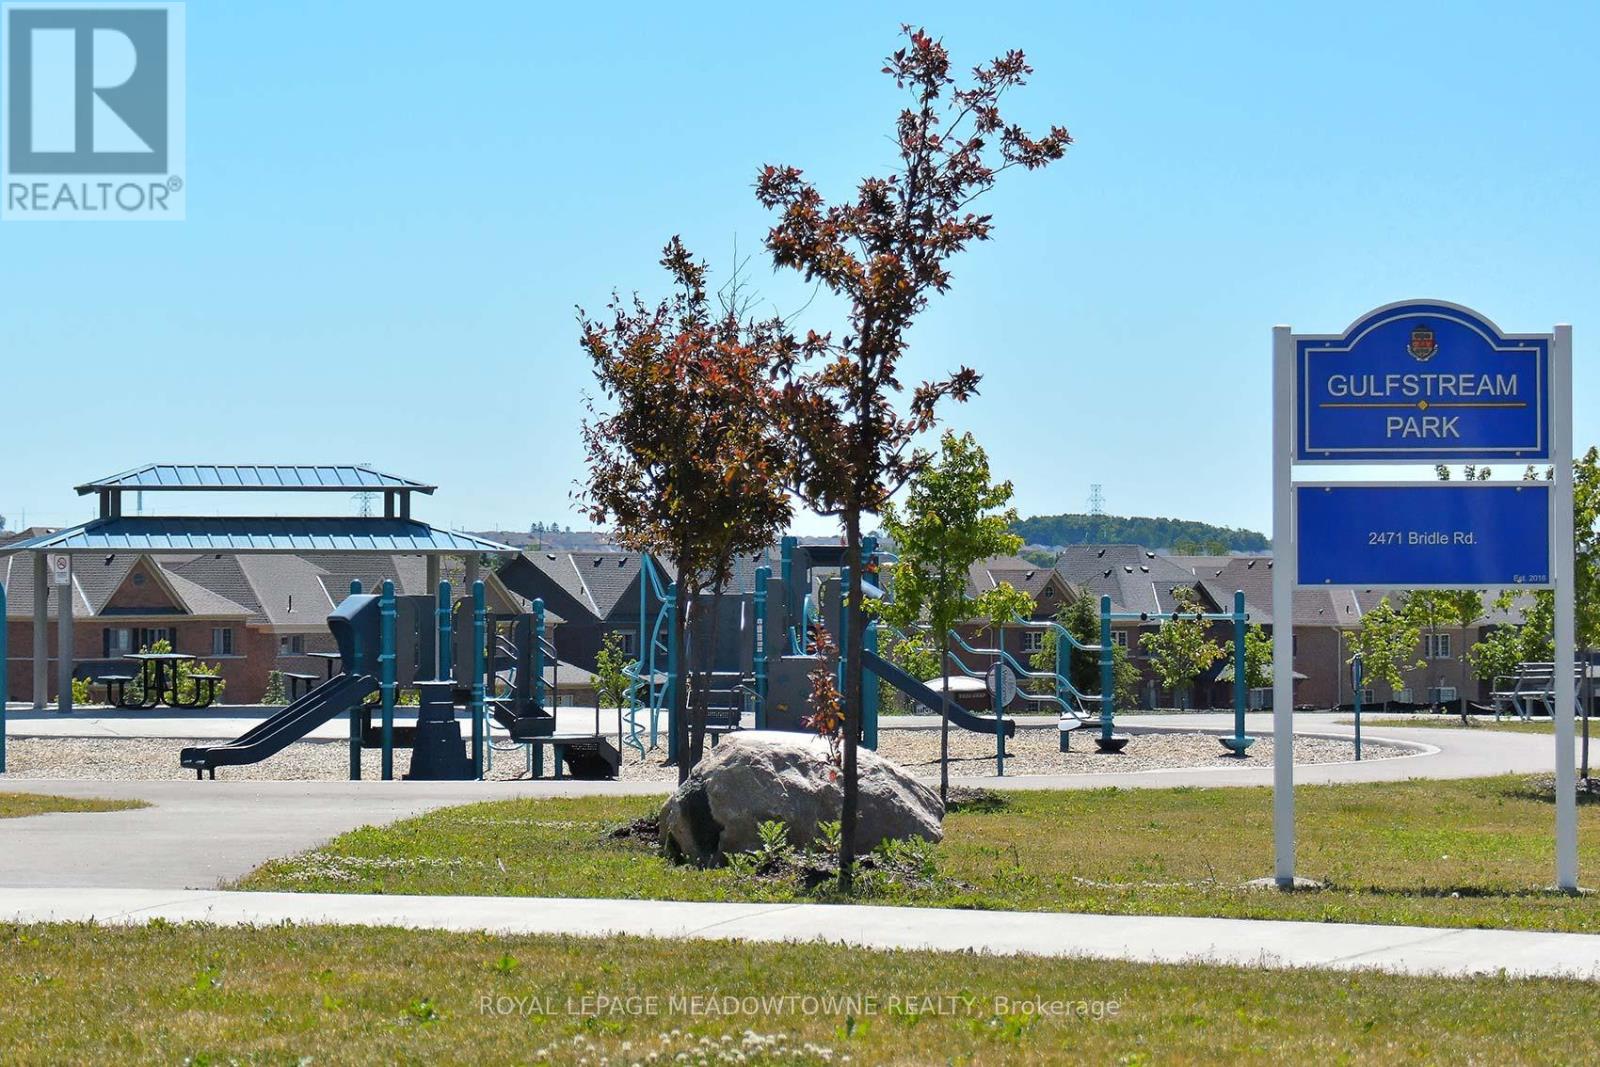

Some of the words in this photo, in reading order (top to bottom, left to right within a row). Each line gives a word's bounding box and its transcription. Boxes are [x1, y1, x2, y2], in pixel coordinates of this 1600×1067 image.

[1327, 374, 1518, 397] GULFSTREAM
[1386, 416, 1460, 438] PARK
[1368, 532, 1402, 545] 2471
[1408, 532, 1449, 545] Bridle
[1454, 532, 1477, 545] Rd.
